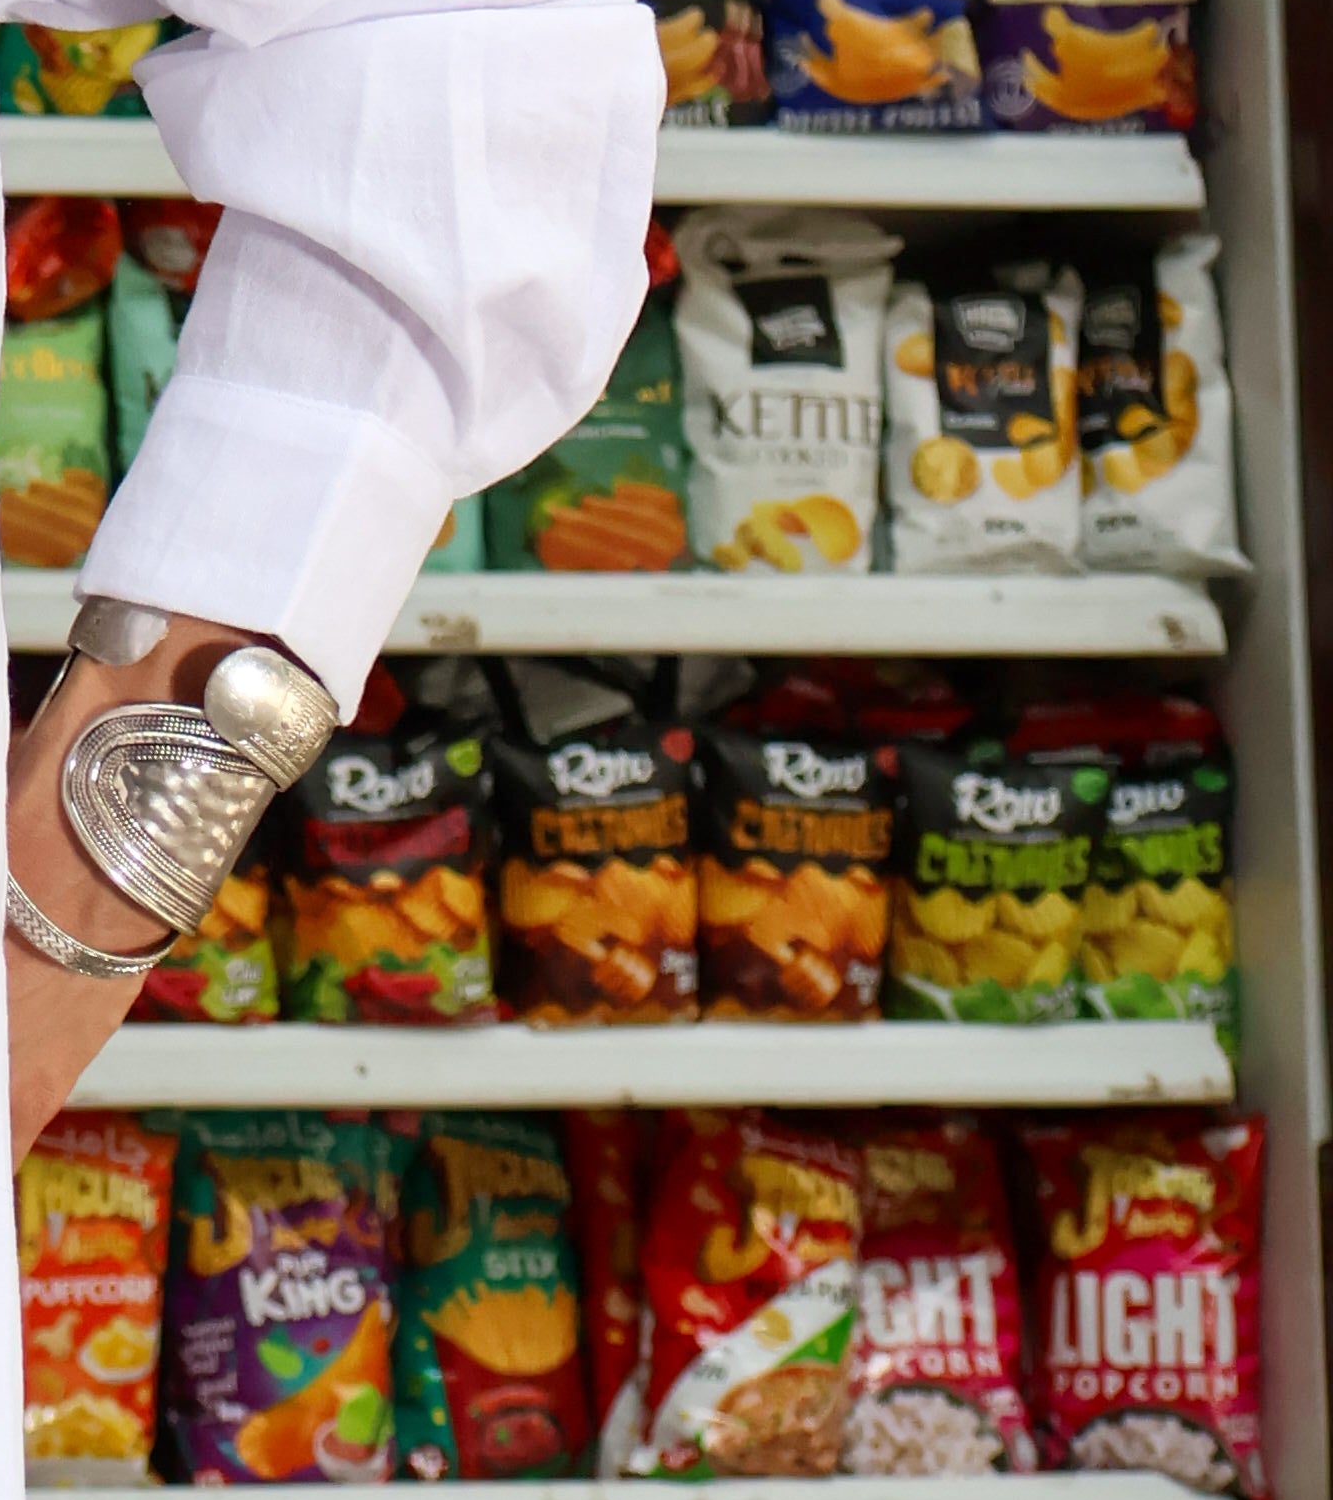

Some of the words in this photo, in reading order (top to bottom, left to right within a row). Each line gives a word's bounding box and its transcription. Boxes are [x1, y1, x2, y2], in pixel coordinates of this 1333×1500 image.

[238, 1267, 365, 1327] KING
[857, 1252, 1006, 1354] GHT
[1049, 1270, 1240, 1368] LIGHT
[1053, 1370, 1240, 1401] POPCORN
